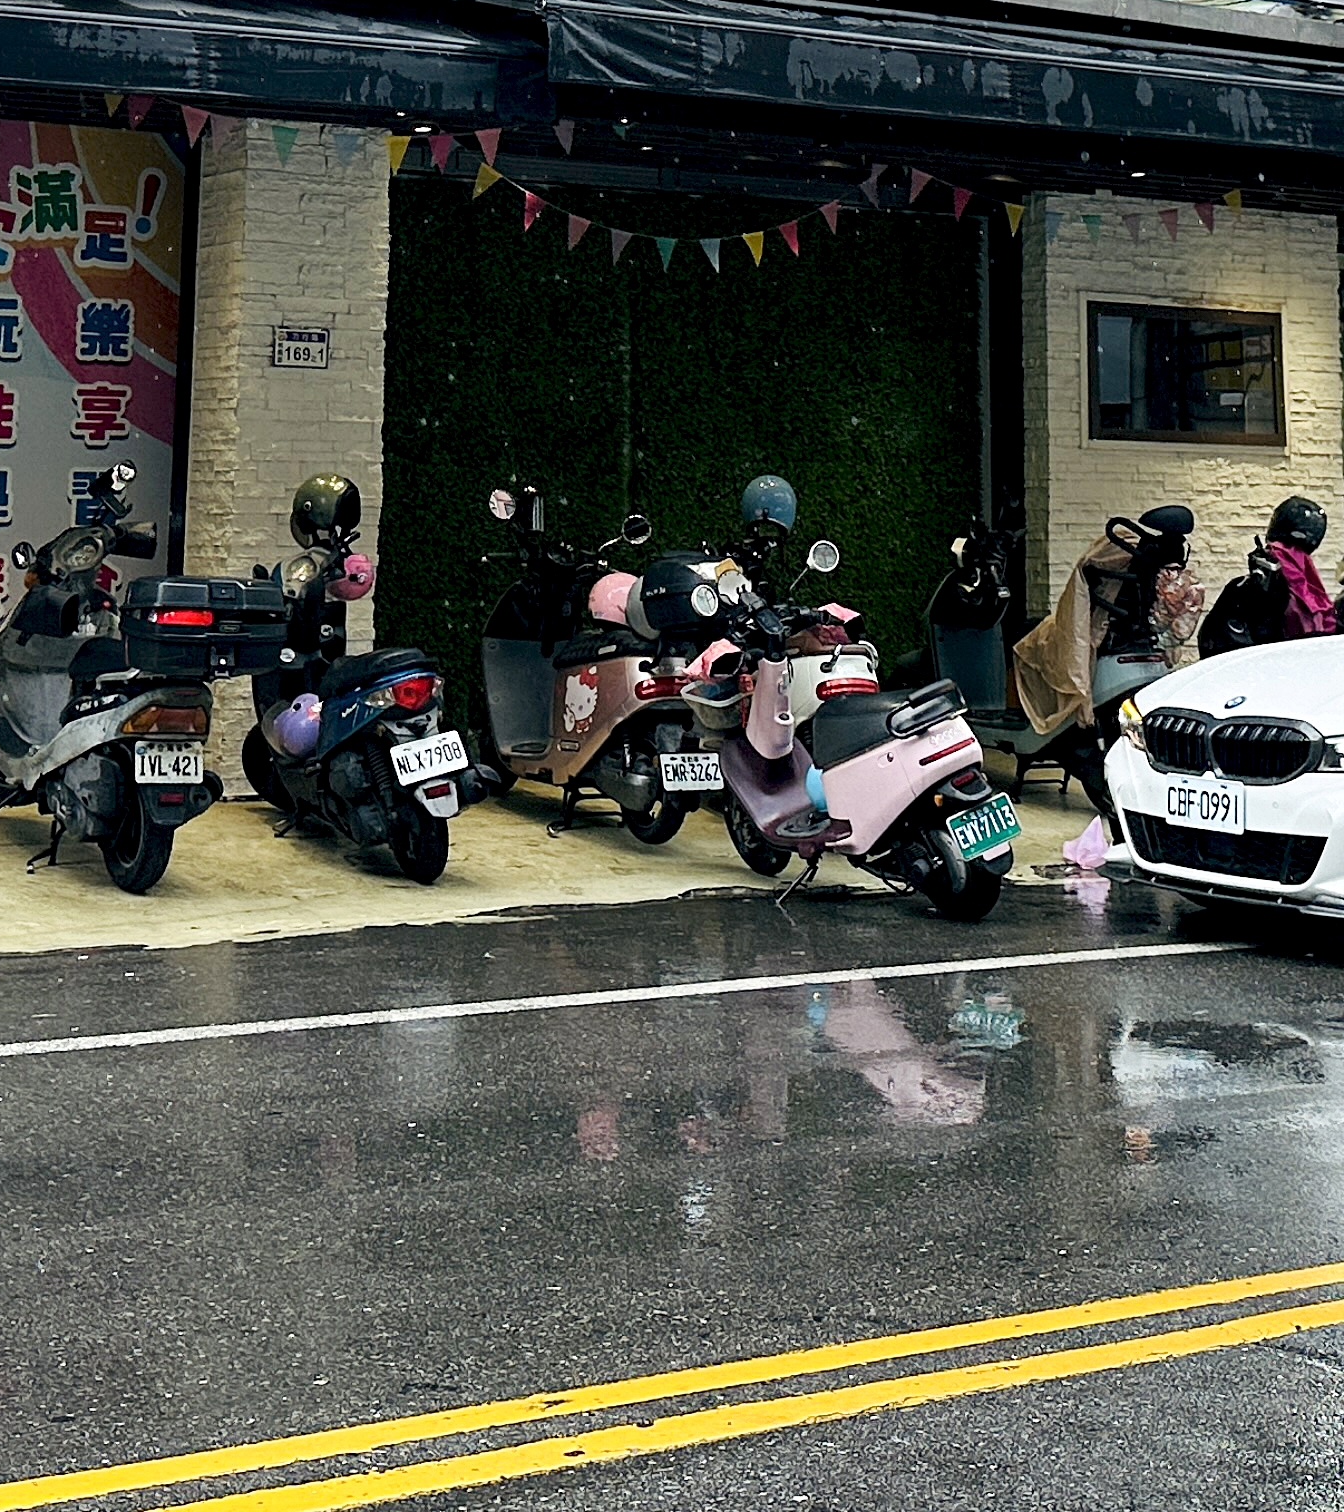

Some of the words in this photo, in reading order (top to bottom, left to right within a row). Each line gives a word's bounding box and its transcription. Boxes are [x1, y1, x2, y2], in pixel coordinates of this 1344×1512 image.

[139, 755, 198, 777] IVL-421
[395, 741, 463, 776] NLX-7908
[1167, 786, 1238, 825] CBF-0991
